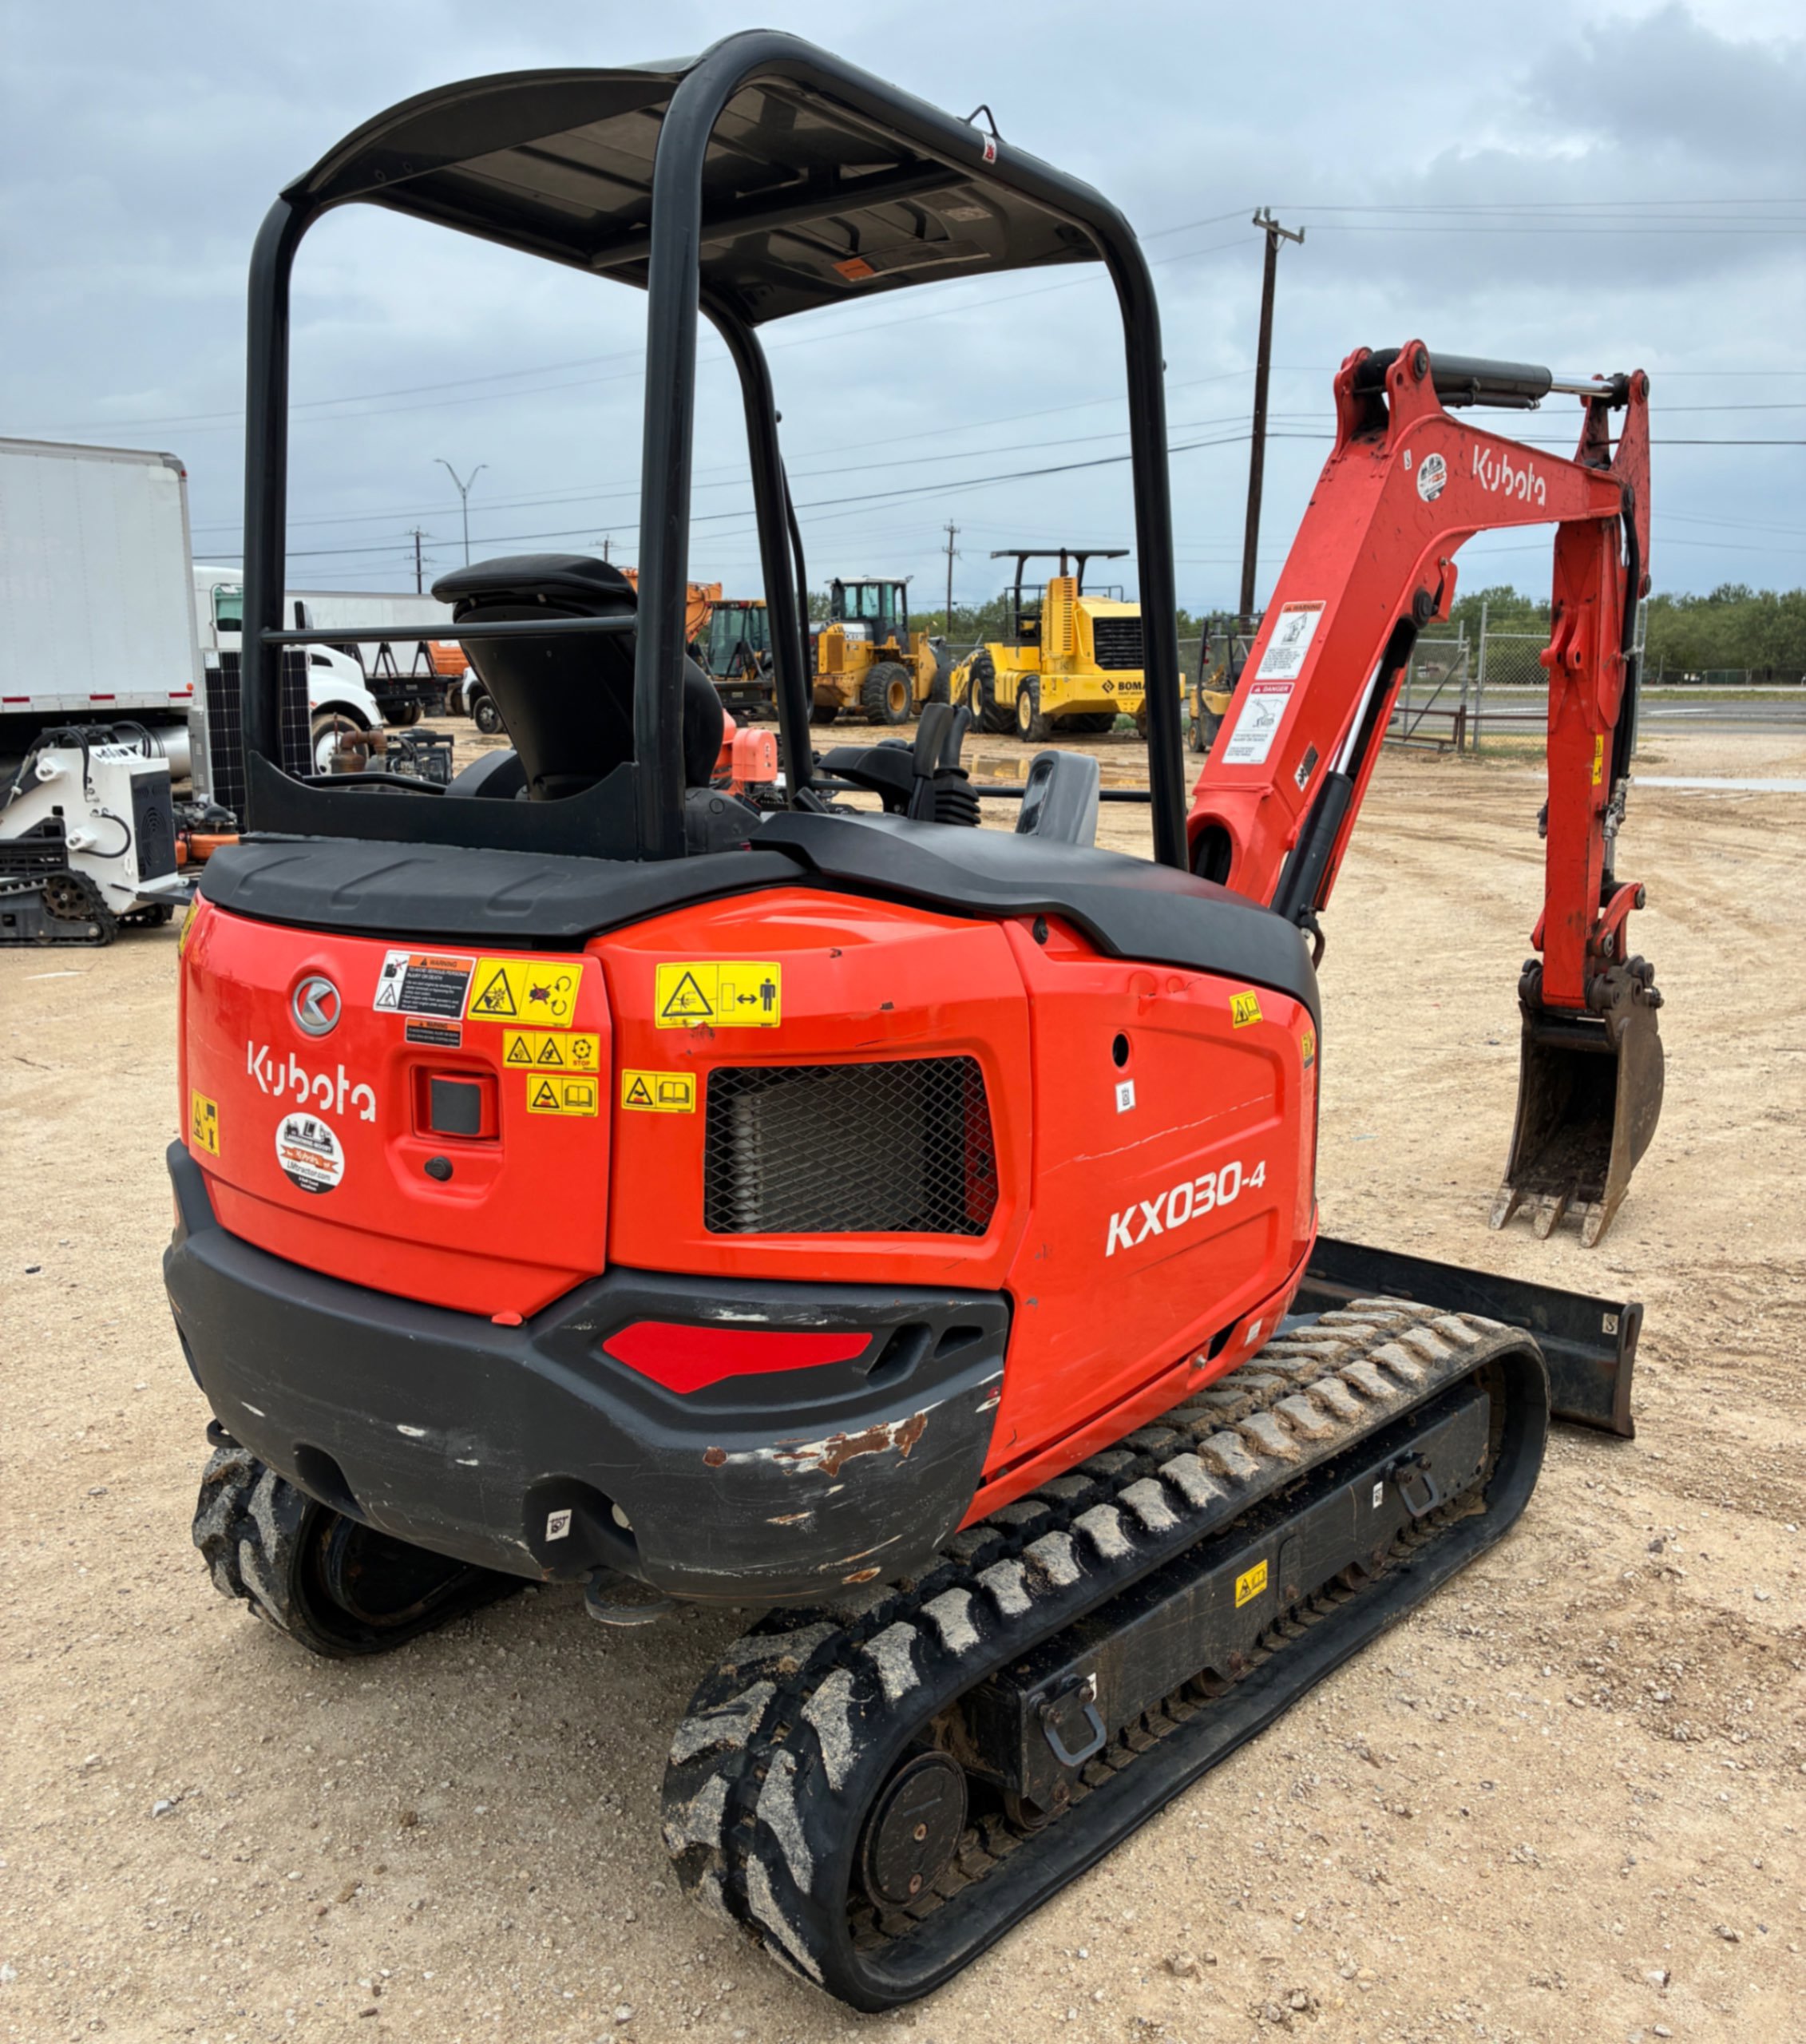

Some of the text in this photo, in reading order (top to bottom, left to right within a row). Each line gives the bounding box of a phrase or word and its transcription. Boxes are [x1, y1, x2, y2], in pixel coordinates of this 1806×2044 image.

[1472, 444, 1547, 506] Kubota
[1118, 681, 1145, 691] BOM
[430, 959, 457, 968] WARNING
[248, 1040, 376, 1123] Kubota
[1105, 1160, 1266, 1258] KX030-4
